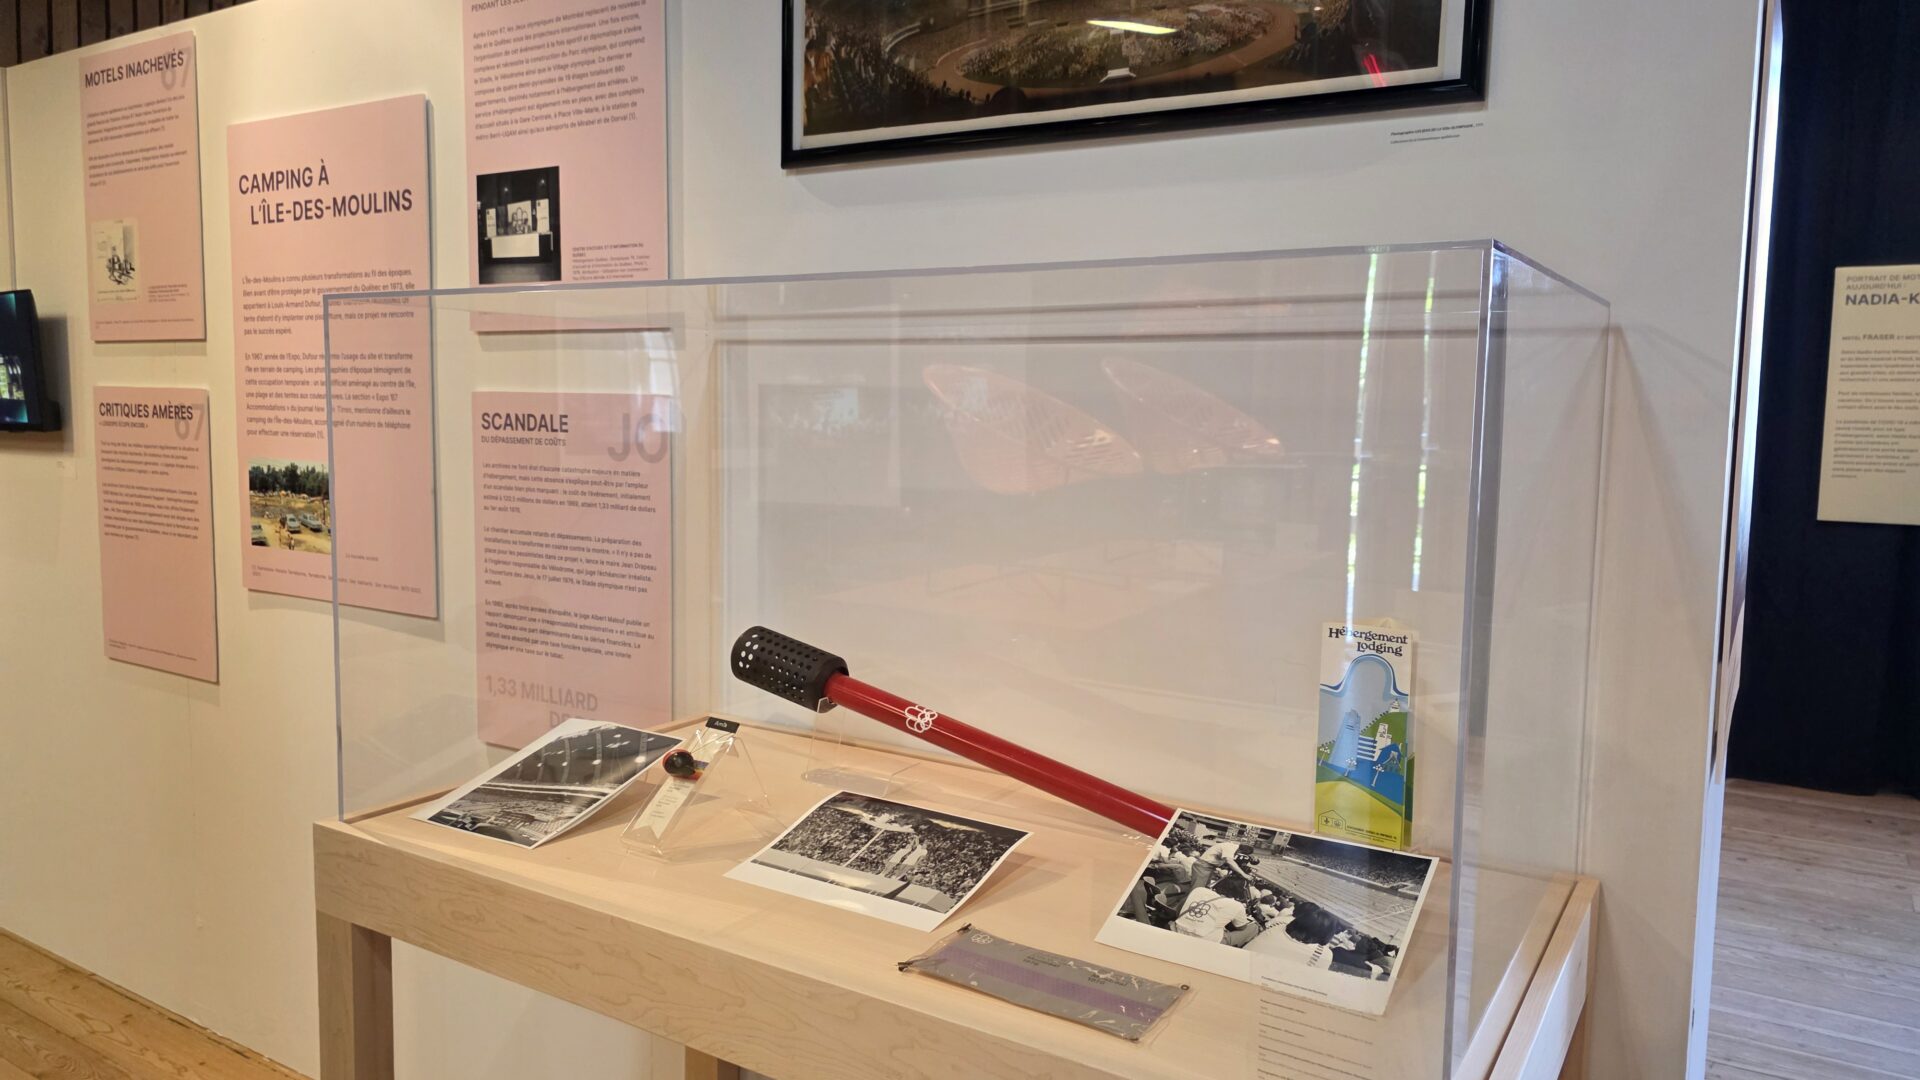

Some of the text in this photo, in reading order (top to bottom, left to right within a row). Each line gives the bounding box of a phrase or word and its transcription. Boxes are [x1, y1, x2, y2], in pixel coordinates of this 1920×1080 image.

[85, 48, 185, 88] MOTELS INACHEVÉS
[238, 158, 330, 195] CAMPING À
[250, 188, 413, 226] L'ÎLE-DES-MOULINS
[98, 400, 194, 421] CRITIQUES AMÈRES
[481, 412, 569, 434] SCANDALE
[481, 434, 566, 448] DU DÉPASSEMENT DE COÛTS
[607, 412, 668, 464] JO
[1356, 641, 1403, 657] Lodging
[486, 674, 598, 712] 1,33 MILLIARD
